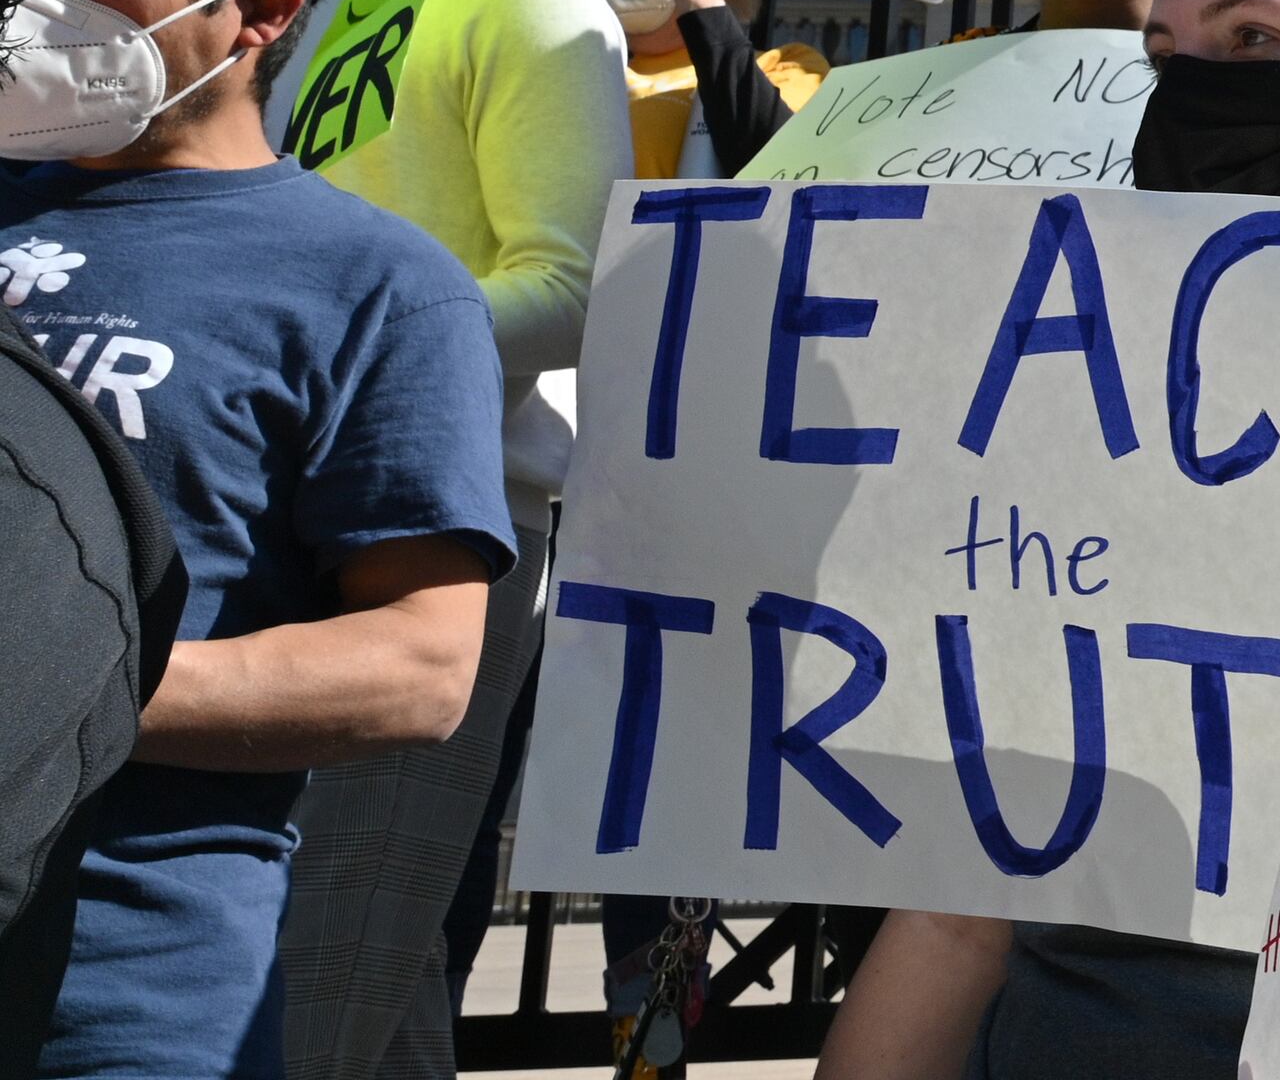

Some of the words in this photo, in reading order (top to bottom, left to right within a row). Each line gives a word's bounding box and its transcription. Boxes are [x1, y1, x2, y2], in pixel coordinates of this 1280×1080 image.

[87, 76, 126, 89] KN95
[816, 71, 956, 136] Vote
[1053, 58, 1157, 104] NO
[878, 138, 1135, 186] censorsh
[43, 311, 92, 325] Human
[94, 312, 139, 330] Rights
[944, 495, 1109, 597] the
